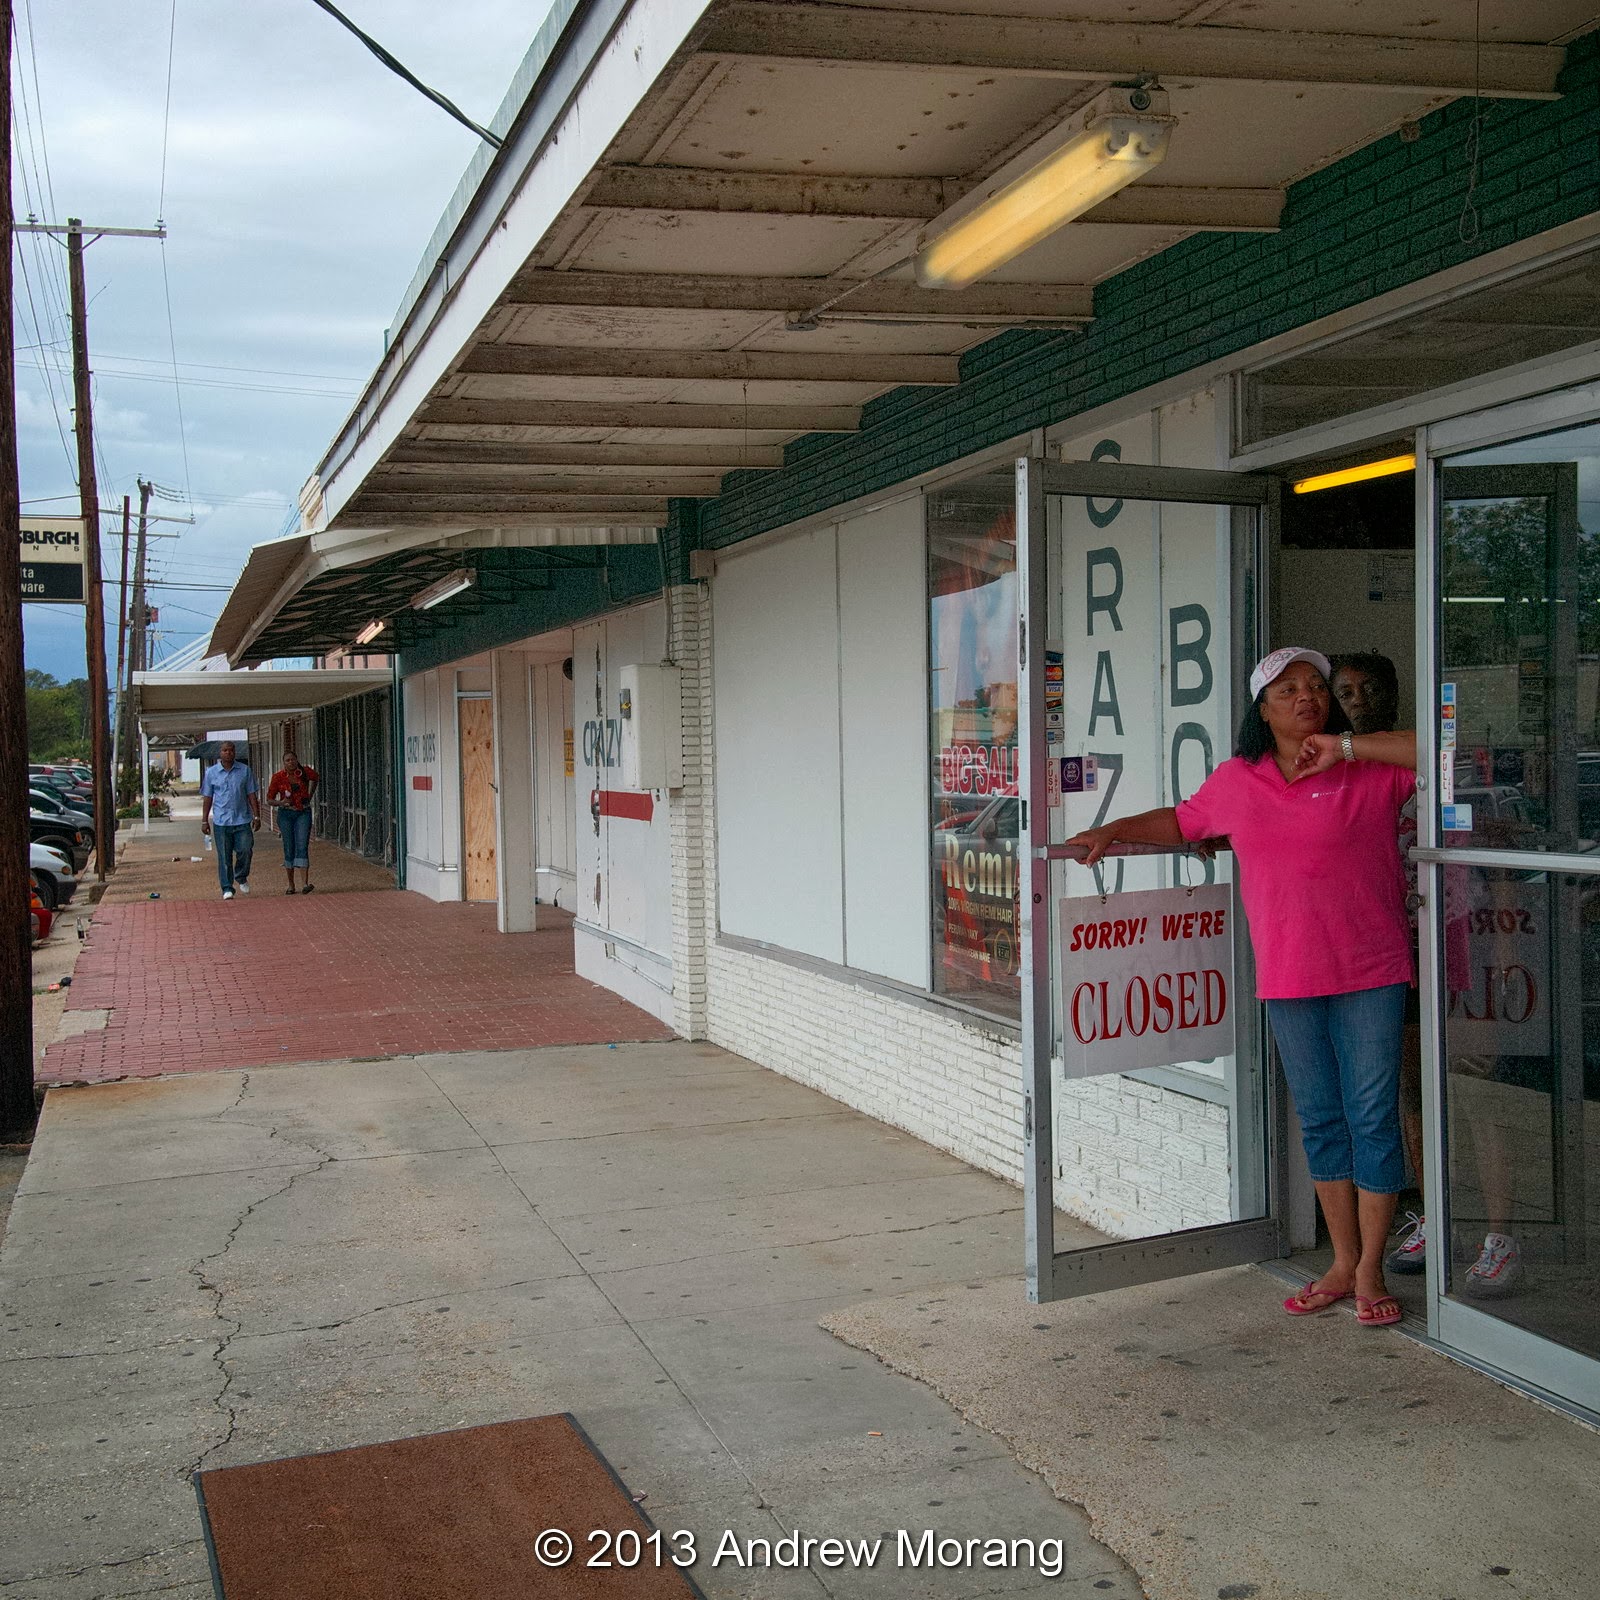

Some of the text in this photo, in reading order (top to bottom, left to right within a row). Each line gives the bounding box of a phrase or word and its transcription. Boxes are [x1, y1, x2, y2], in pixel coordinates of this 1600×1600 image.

[583, 718, 622, 767] CRAZY
[942, 745, 973, 796] BIG
[945, 833, 1012, 899] Remi
[997, 907, 1012, 924] HAIR
[1070, 909, 1225, 952] SORRY! WE'RE
[1070, 969, 1227, 1045] CLOSED
